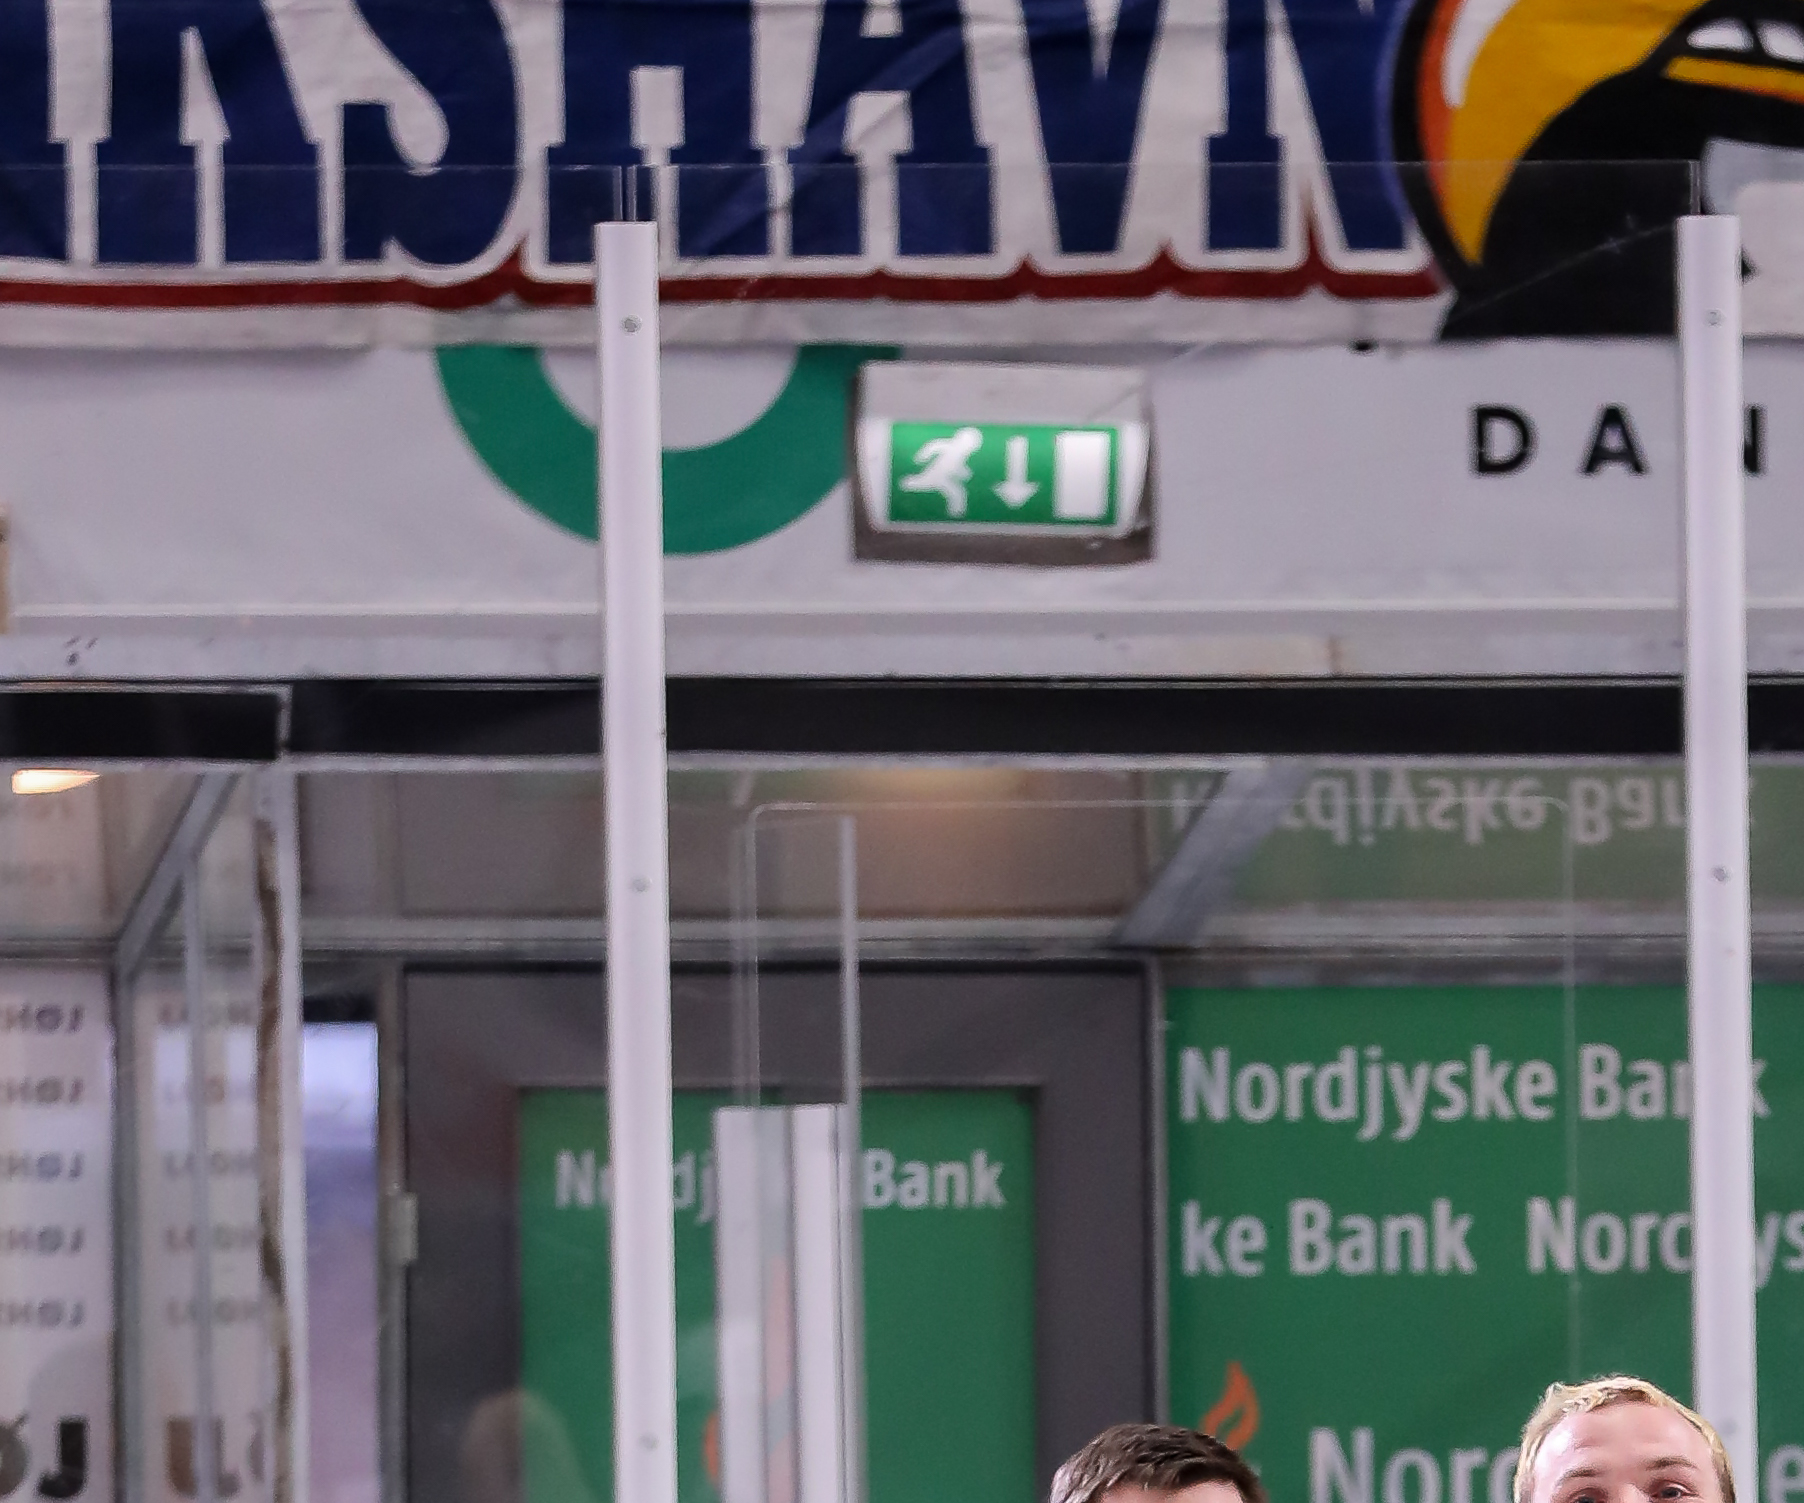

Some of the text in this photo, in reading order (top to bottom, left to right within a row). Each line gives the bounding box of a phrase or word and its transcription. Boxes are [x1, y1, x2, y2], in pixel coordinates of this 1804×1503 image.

[1180, 1045, 1557, 1142] Nordjyske
[861, 1149, 1008, 1211] Bank
[1182, 1201, 1269, 1276] ke
[1290, 1198, 1478, 1276] Bank
